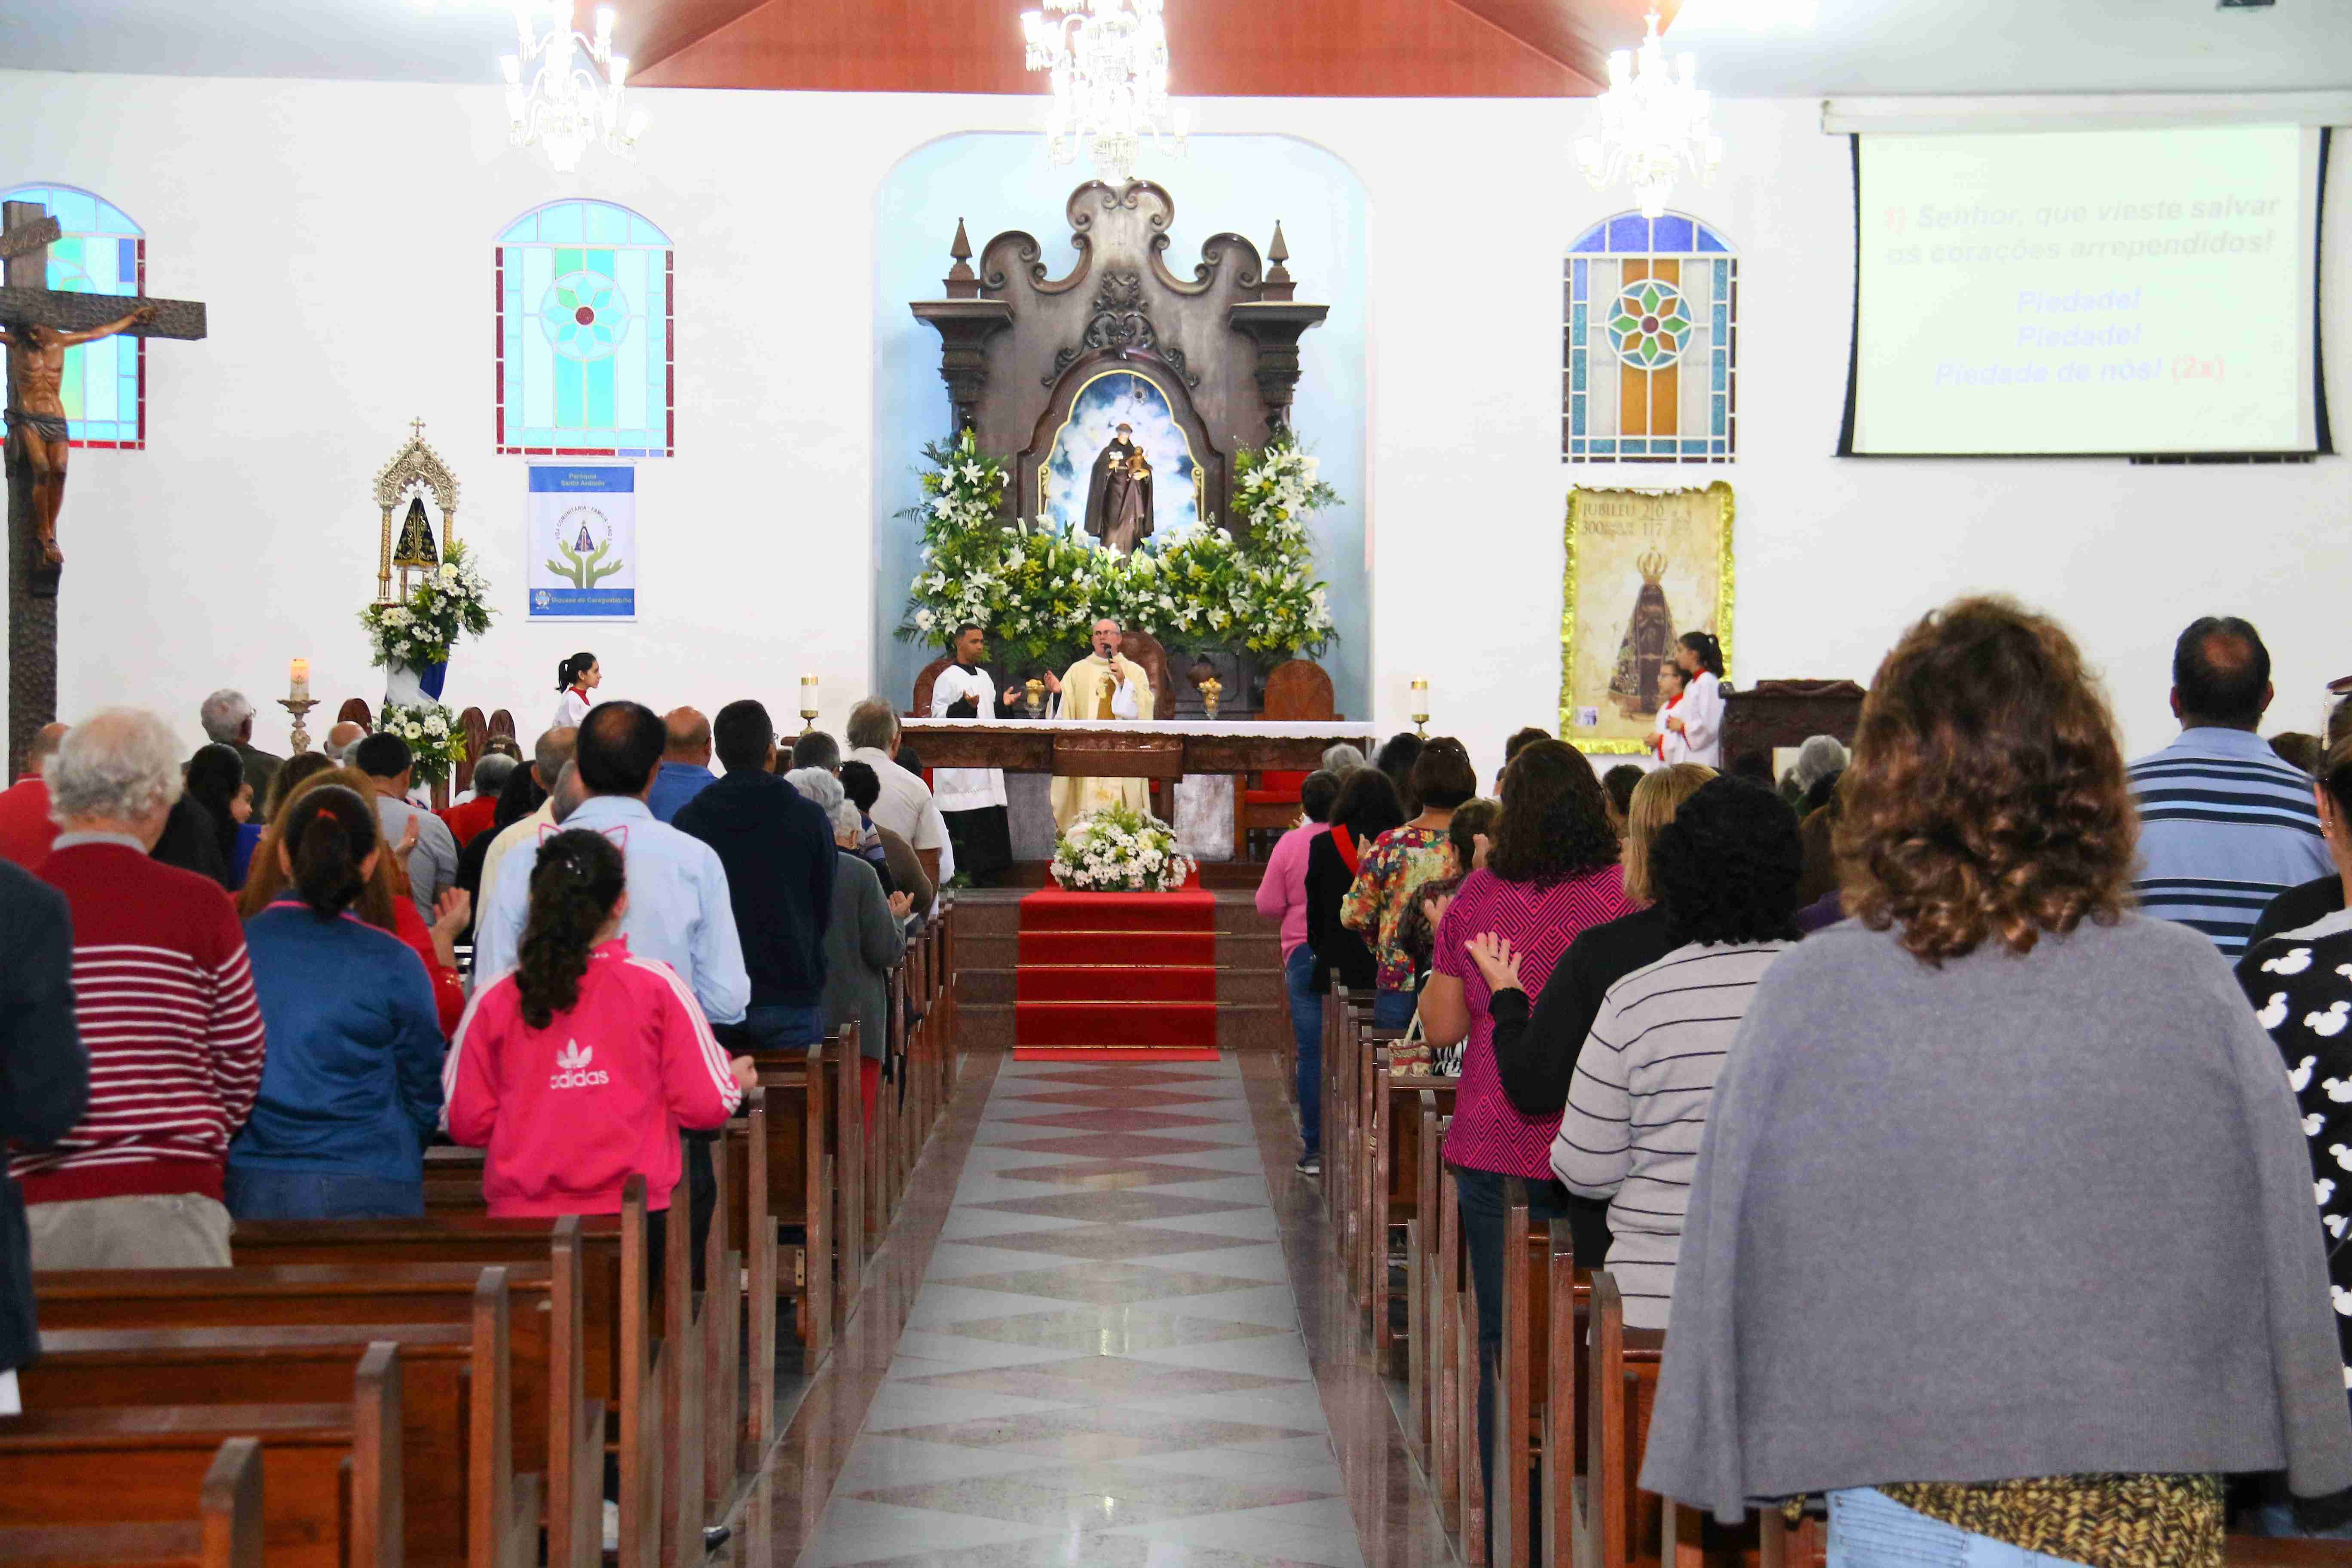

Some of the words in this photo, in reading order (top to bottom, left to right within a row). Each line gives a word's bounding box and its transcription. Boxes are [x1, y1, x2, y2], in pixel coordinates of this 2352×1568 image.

[1917, 204, 2023, 228] Senhor,
[2036, 206, 2087, 227] que
[2098, 199, 2182, 220] vieste
[2190, 193, 2282, 220] salvar
[1885, 248, 1921, 263] os
[2070, 228, 2277, 261] arrependidos!
[2016, 288, 2141, 313] Piedade!
[2016, 323, 2141, 347] Piedade!
[1935, 360, 2049, 386] Piedade
[2057, 360, 2092, 382] de
[2100, 357, 2162, 382] nós!
[2171, 353, 2225, 384] (2x)
[1583, 503, 1635, 516] JUBILEU
[1582, 520, 1604, 534] 300
[550, 1069, 609, 1090] adidas
